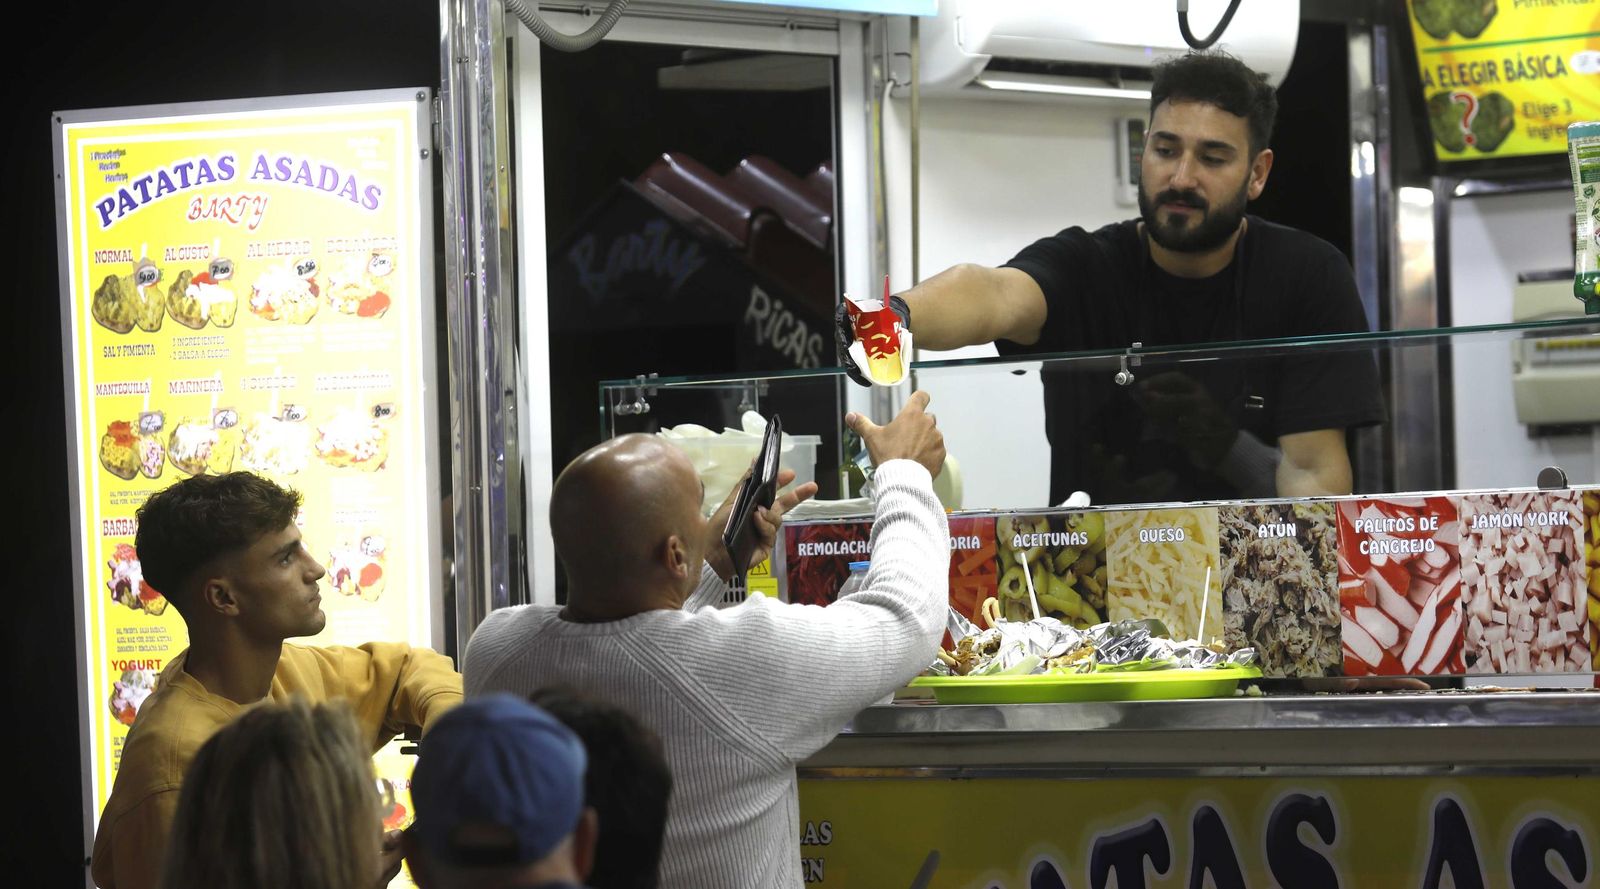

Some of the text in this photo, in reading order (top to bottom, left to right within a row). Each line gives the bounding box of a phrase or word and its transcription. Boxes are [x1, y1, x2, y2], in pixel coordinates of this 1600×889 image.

[1423, 69, 1436, 90] A
[1438, 60, 1500, 88] ELEGIR
[1503, 52, 1568, 83] BÁSICA
[1522, 101, 1559, 120] Elige
[95, 154, 382, 228] PATATAS ASADAS
[188, 195, 268, 230] BARTY
[95, 250, 133, 263] NORMAL
[165, 246, 209, 261] AL GUSTO
[103, 344, 156, 358] SAL Y PIMIENTA
[96, 382, 150, 396] MANTEQUILLA
[169, 379, 224, 394] MARINERA
[1355, 516, 1439, 533] PALITOS DE
[1471, 508, 1570, 529] JAMÓN YORK
[1138, 527, 1185, 543] QUESO
[1258, 518, 1297, 538] ATÚN
[950, 535, 981, 550] ORIA
[1012, 531, 1088, 547] ACEITUNAS
[1359, 538, 1436, 555] CANGREJO
[798, 540, 873, 556] REMOLACHA
[111, 659, 162, 672] YOGURT
[800, 820, 833, 846] AS
